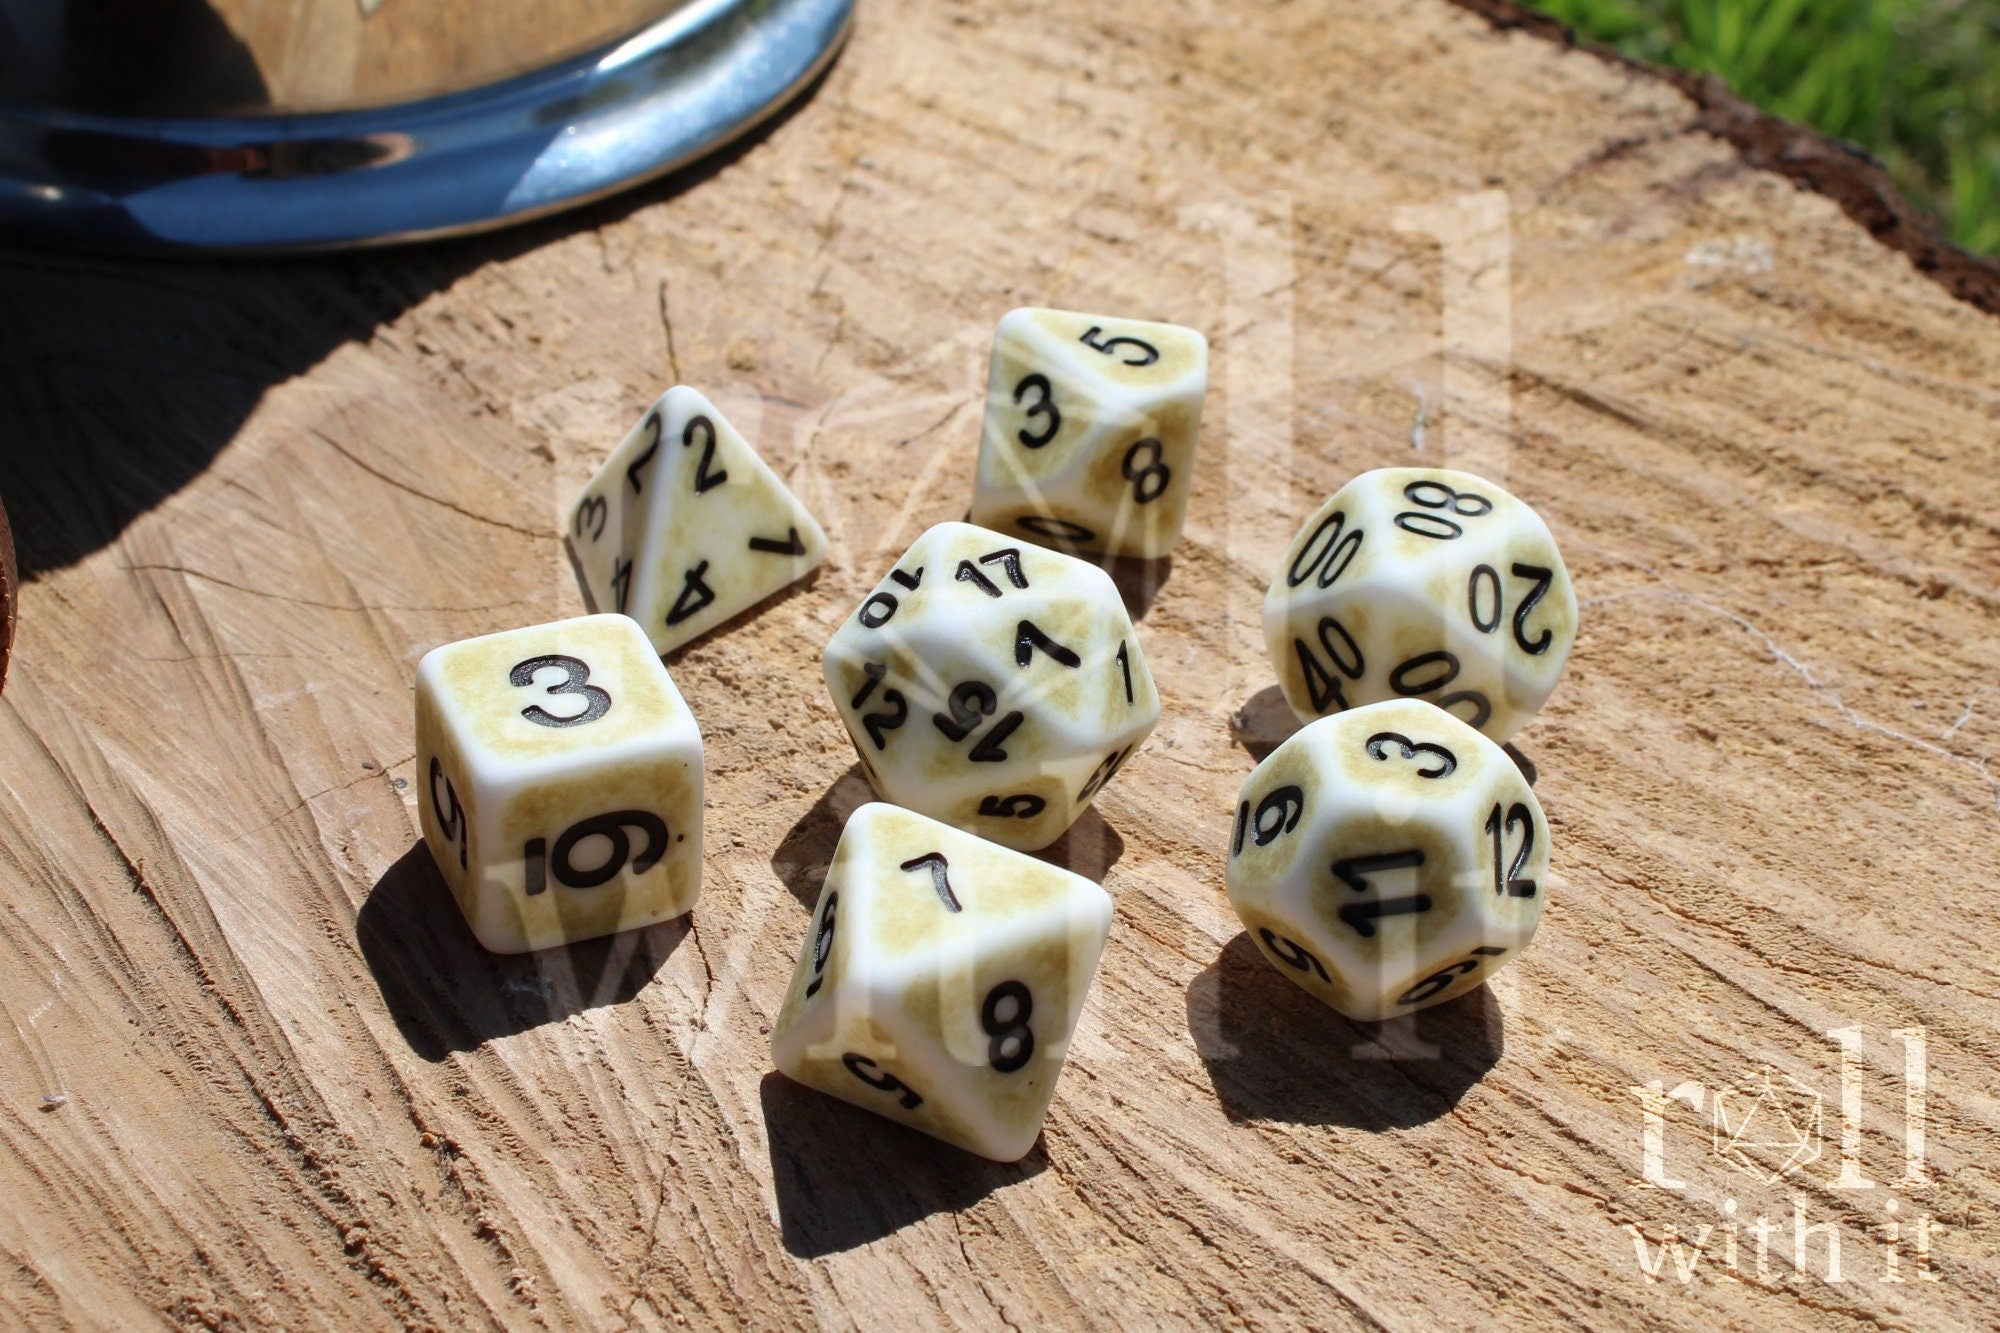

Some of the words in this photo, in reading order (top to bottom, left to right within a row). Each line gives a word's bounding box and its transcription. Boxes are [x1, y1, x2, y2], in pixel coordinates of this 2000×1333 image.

[1079, 326, 1159, 366] 5
[1014, 373, 1060, 448] 3
[627, 412, 662, 494] 2
[683, 415, 727, 494] 2
[1122, 437, 1170, 505] 8
[576, 496, 607, 542] 3
[748, 527, 806, 556] 1
[1394, 481, 1492, 540] 80
[955, 548, 1030, 598] 17
[1287, 510, 1364, 589] 00
[666, 560, 715, 626] 4
[858, 566, 923, 628] 10
[1468, 562, 1553, 656] 20
[1014, 619, 1081, 669] 7
[1294, 616, 1365, 714] 40
[509, 654, 612, 728] 3
[851, 662, 907, 750] 12
[932, 680, 1025, 763] 15
[1365, 732, 1457, 779] 3
[429, 756, 467, 872] 5
[979, 793, 1046, 819] 5
[900, 851, 963, 913] 7
[1485, 802, 1537, 898] 12
[1331, 850, 1432, 938] 11
[981, 980, 1034, 1074] 8
[841, 1052, 925, 1110] 5
